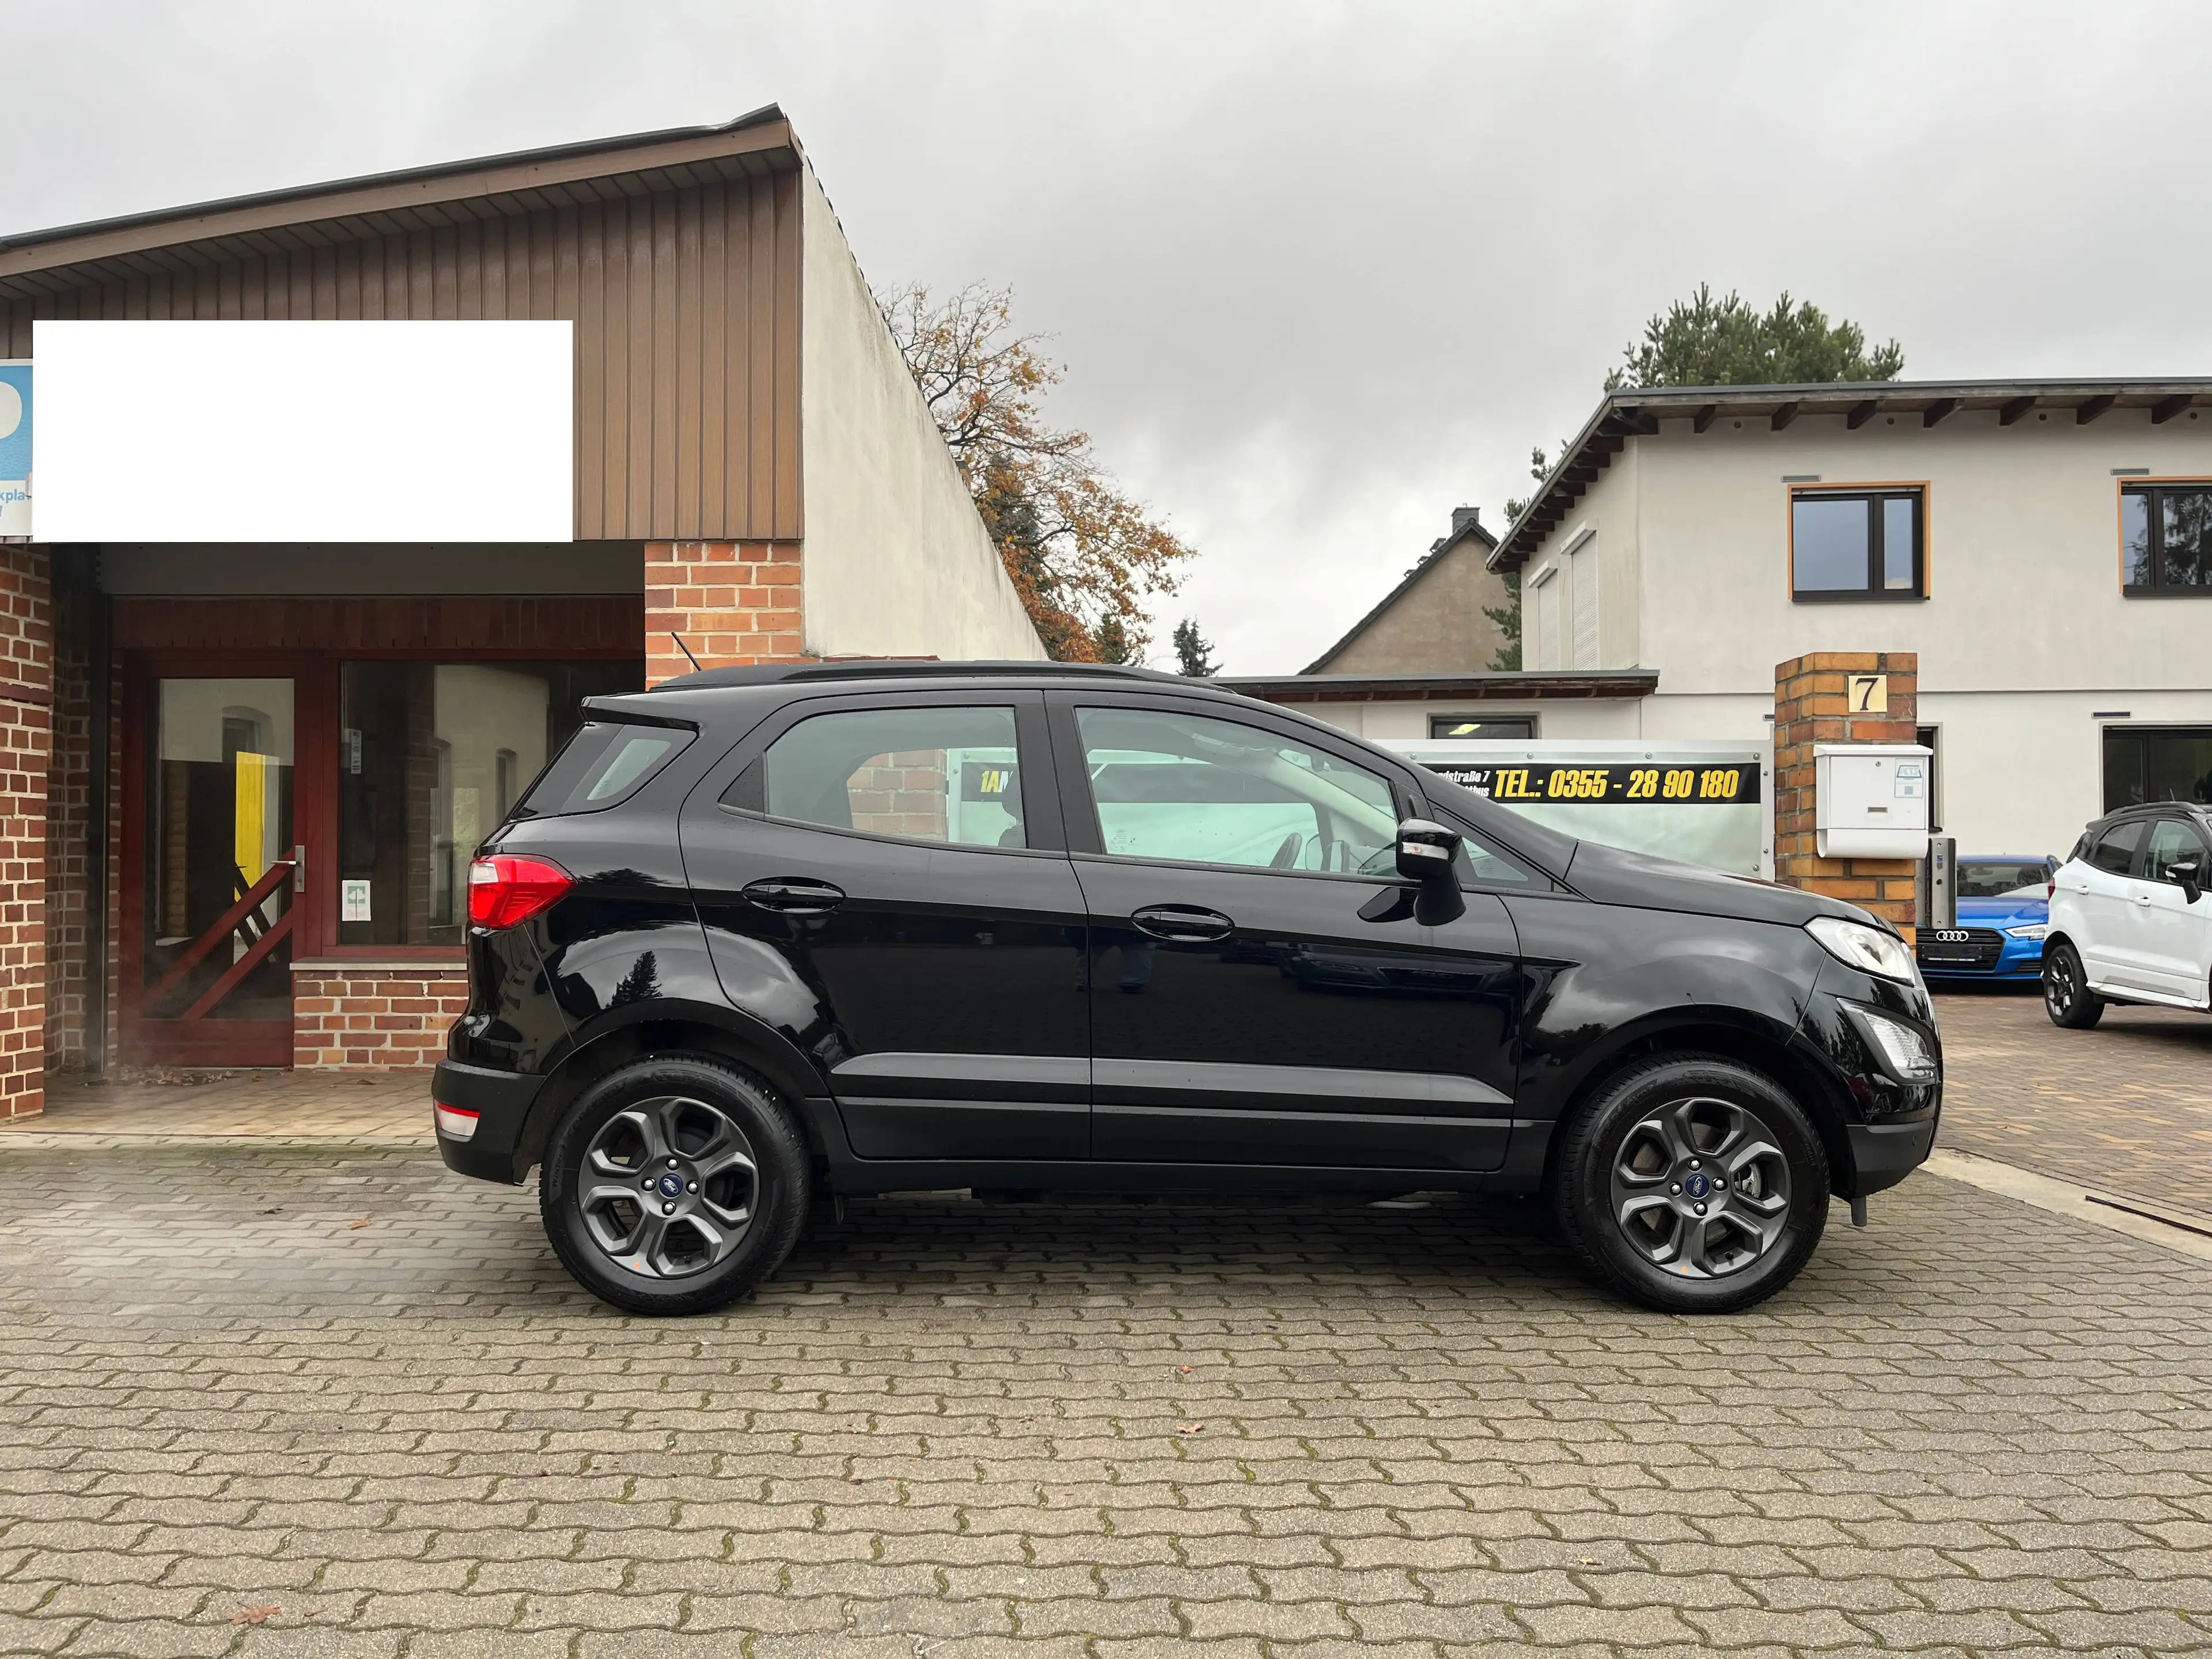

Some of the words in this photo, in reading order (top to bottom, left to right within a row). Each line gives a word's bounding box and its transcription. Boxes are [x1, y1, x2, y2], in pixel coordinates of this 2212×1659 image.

[1855, 677, 1879, 710] 7
[1482, 770, 1491, 783] 7
[1495, 770, 1544, 798] TEL.:
[1548, 770, 1609, 798] 0355
[1627, 770, 1659, 798] 28
[1662, 770, 1694, 798] 90
[1699, 770, 1740, 798] 180
